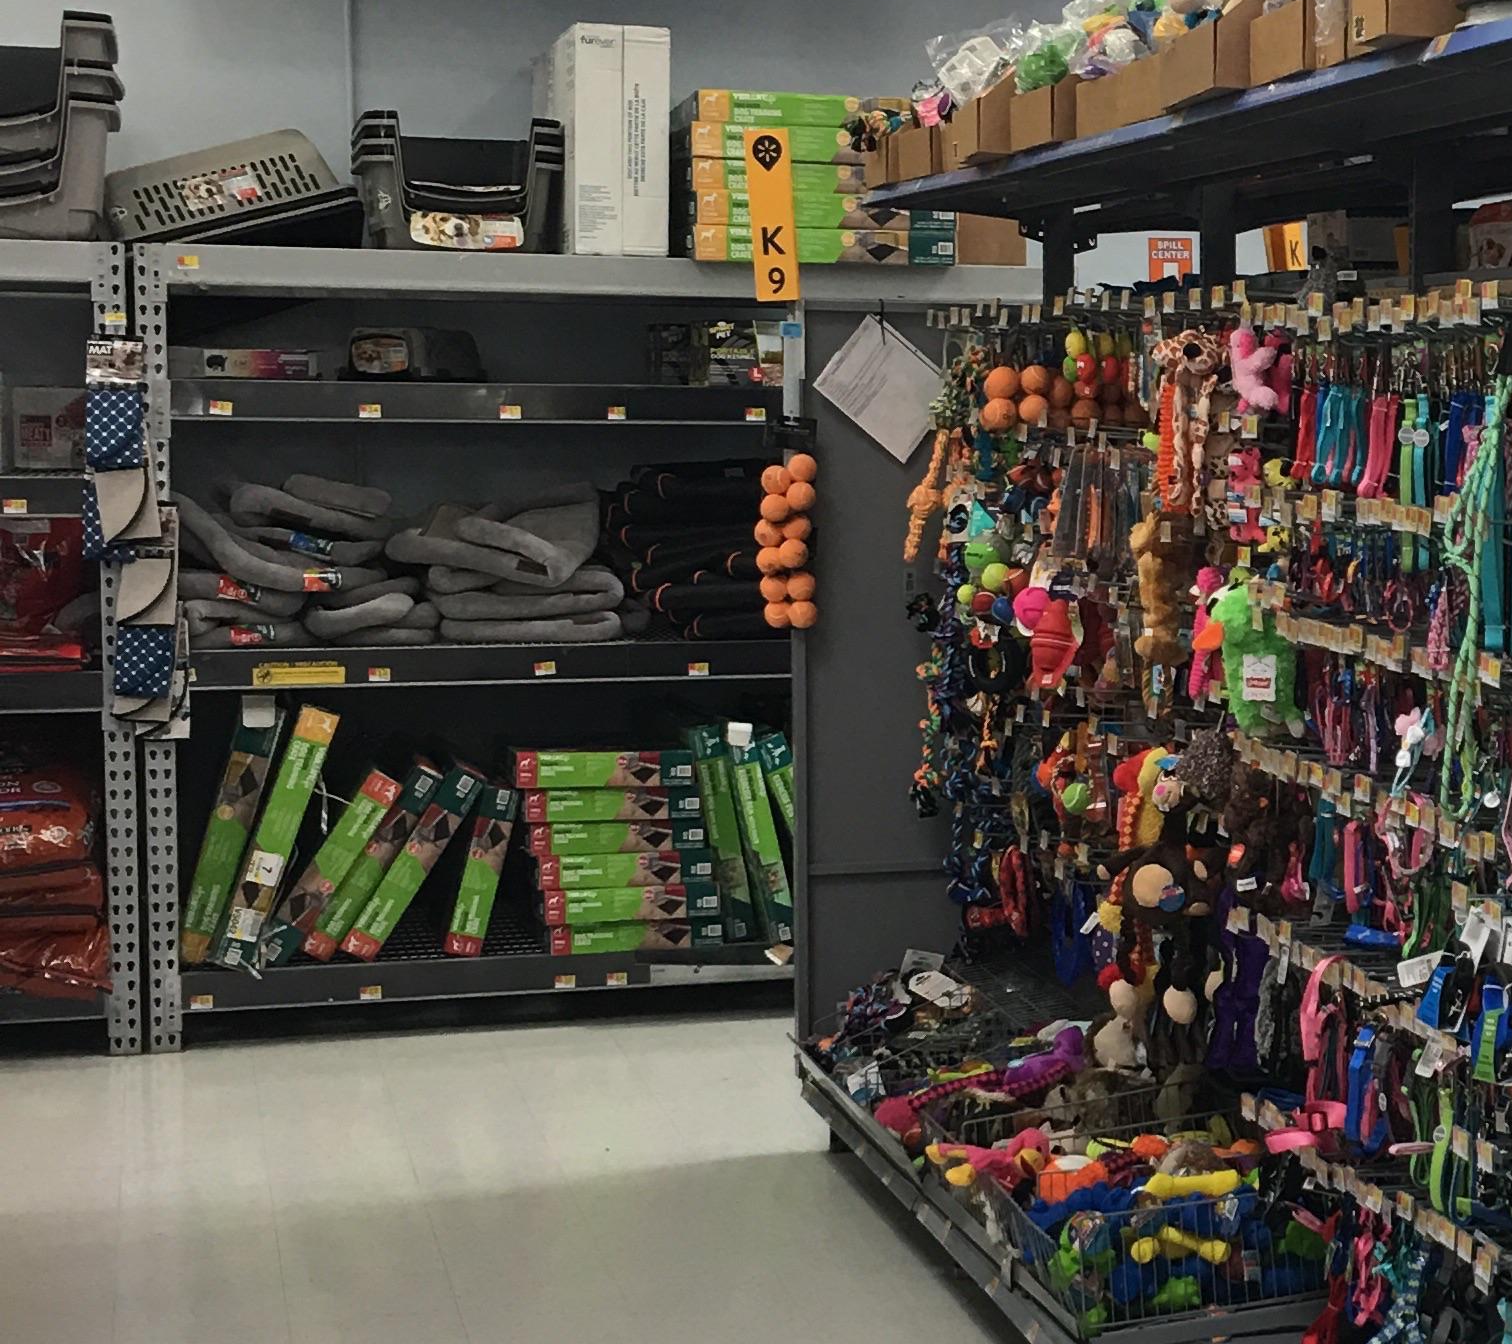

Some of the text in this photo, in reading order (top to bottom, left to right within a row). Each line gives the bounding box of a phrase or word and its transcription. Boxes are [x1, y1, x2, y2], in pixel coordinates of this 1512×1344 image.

[762, 226, 786, 255] K
[1158, 241, 1184, 249] SPILL
[1152, 250, 1189, 259] CENTER
[1290, 240, 1301, 266] K
[769, 267, 785, 294] 9
[88, 345, 113, 354] MAT
